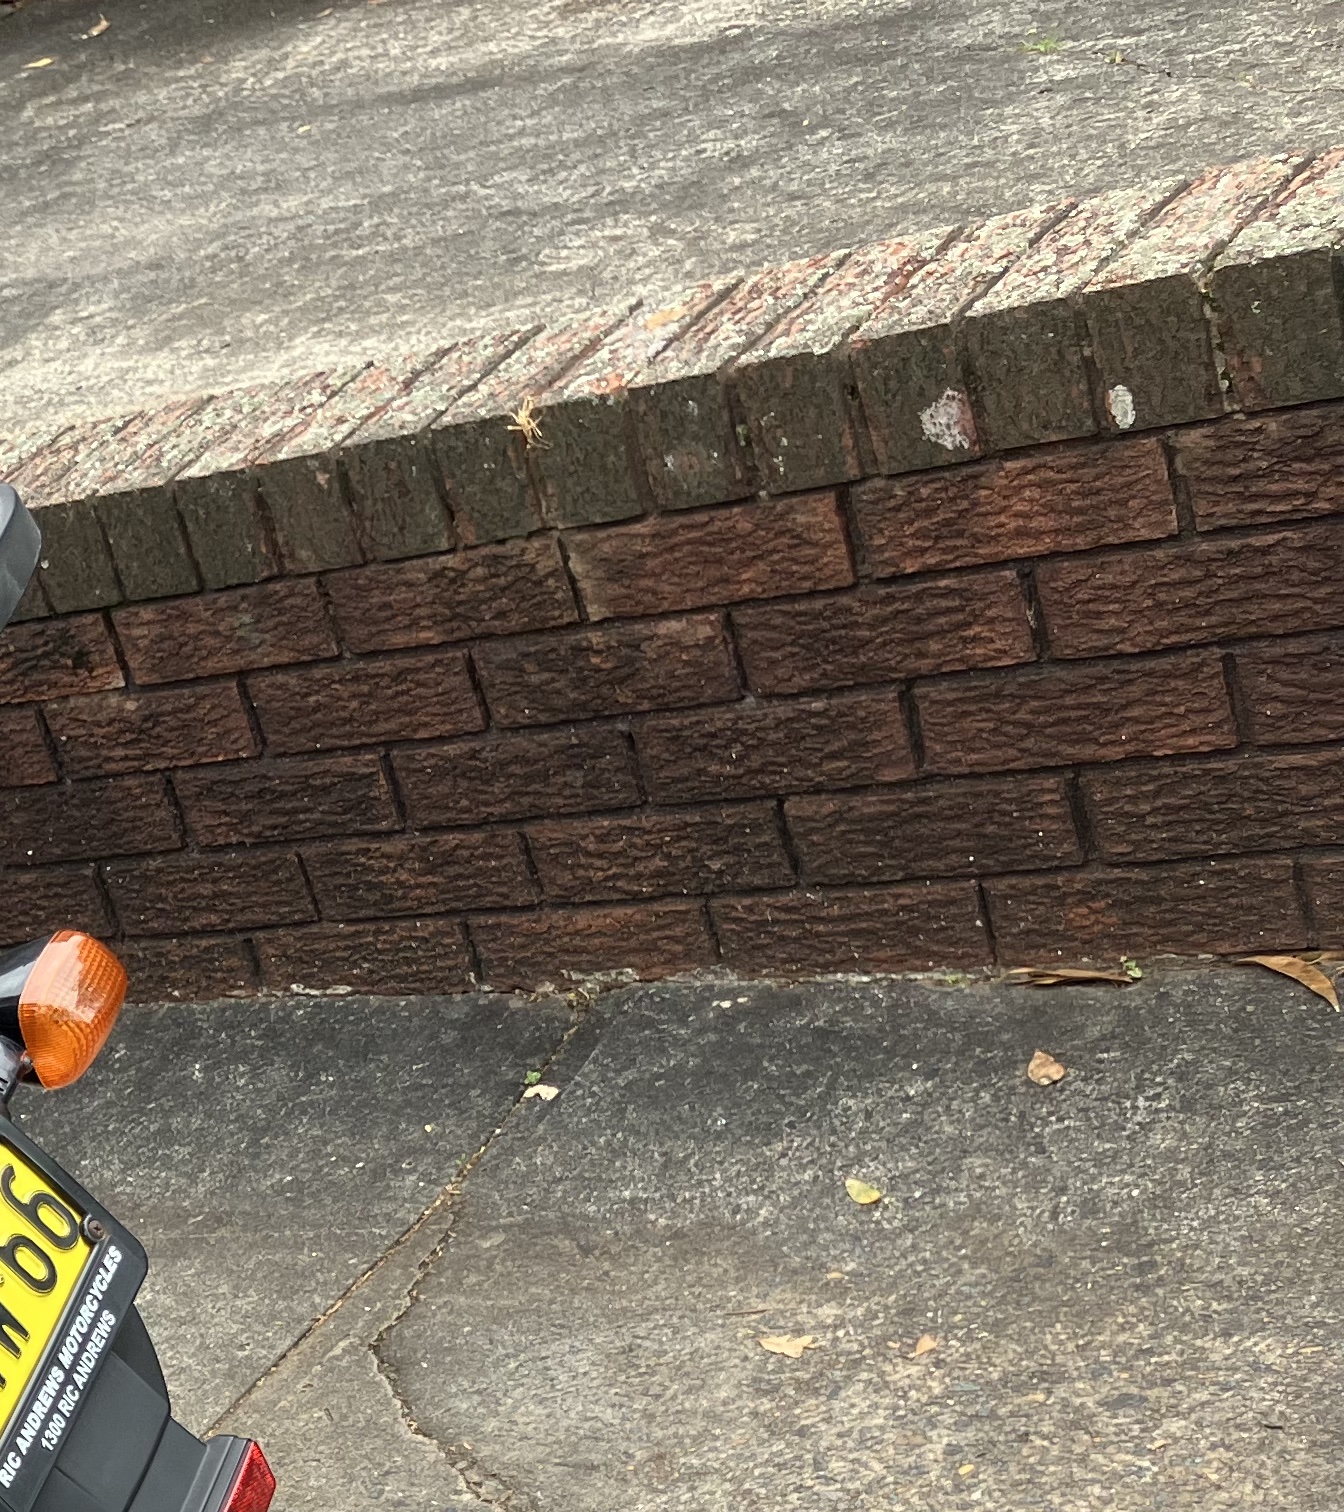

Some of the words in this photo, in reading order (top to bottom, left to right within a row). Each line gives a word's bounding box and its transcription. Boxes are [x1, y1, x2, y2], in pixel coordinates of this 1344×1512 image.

[15, 1366, 65, 1455] ANDREWS
[58, 1245, 123, 1370] MOTORCYCLES
[41, 1412, 66, 1451] 1300
[57, 1384, 80, 1418] RIC
[72, 1309, 116, 1391] ANDREWS
